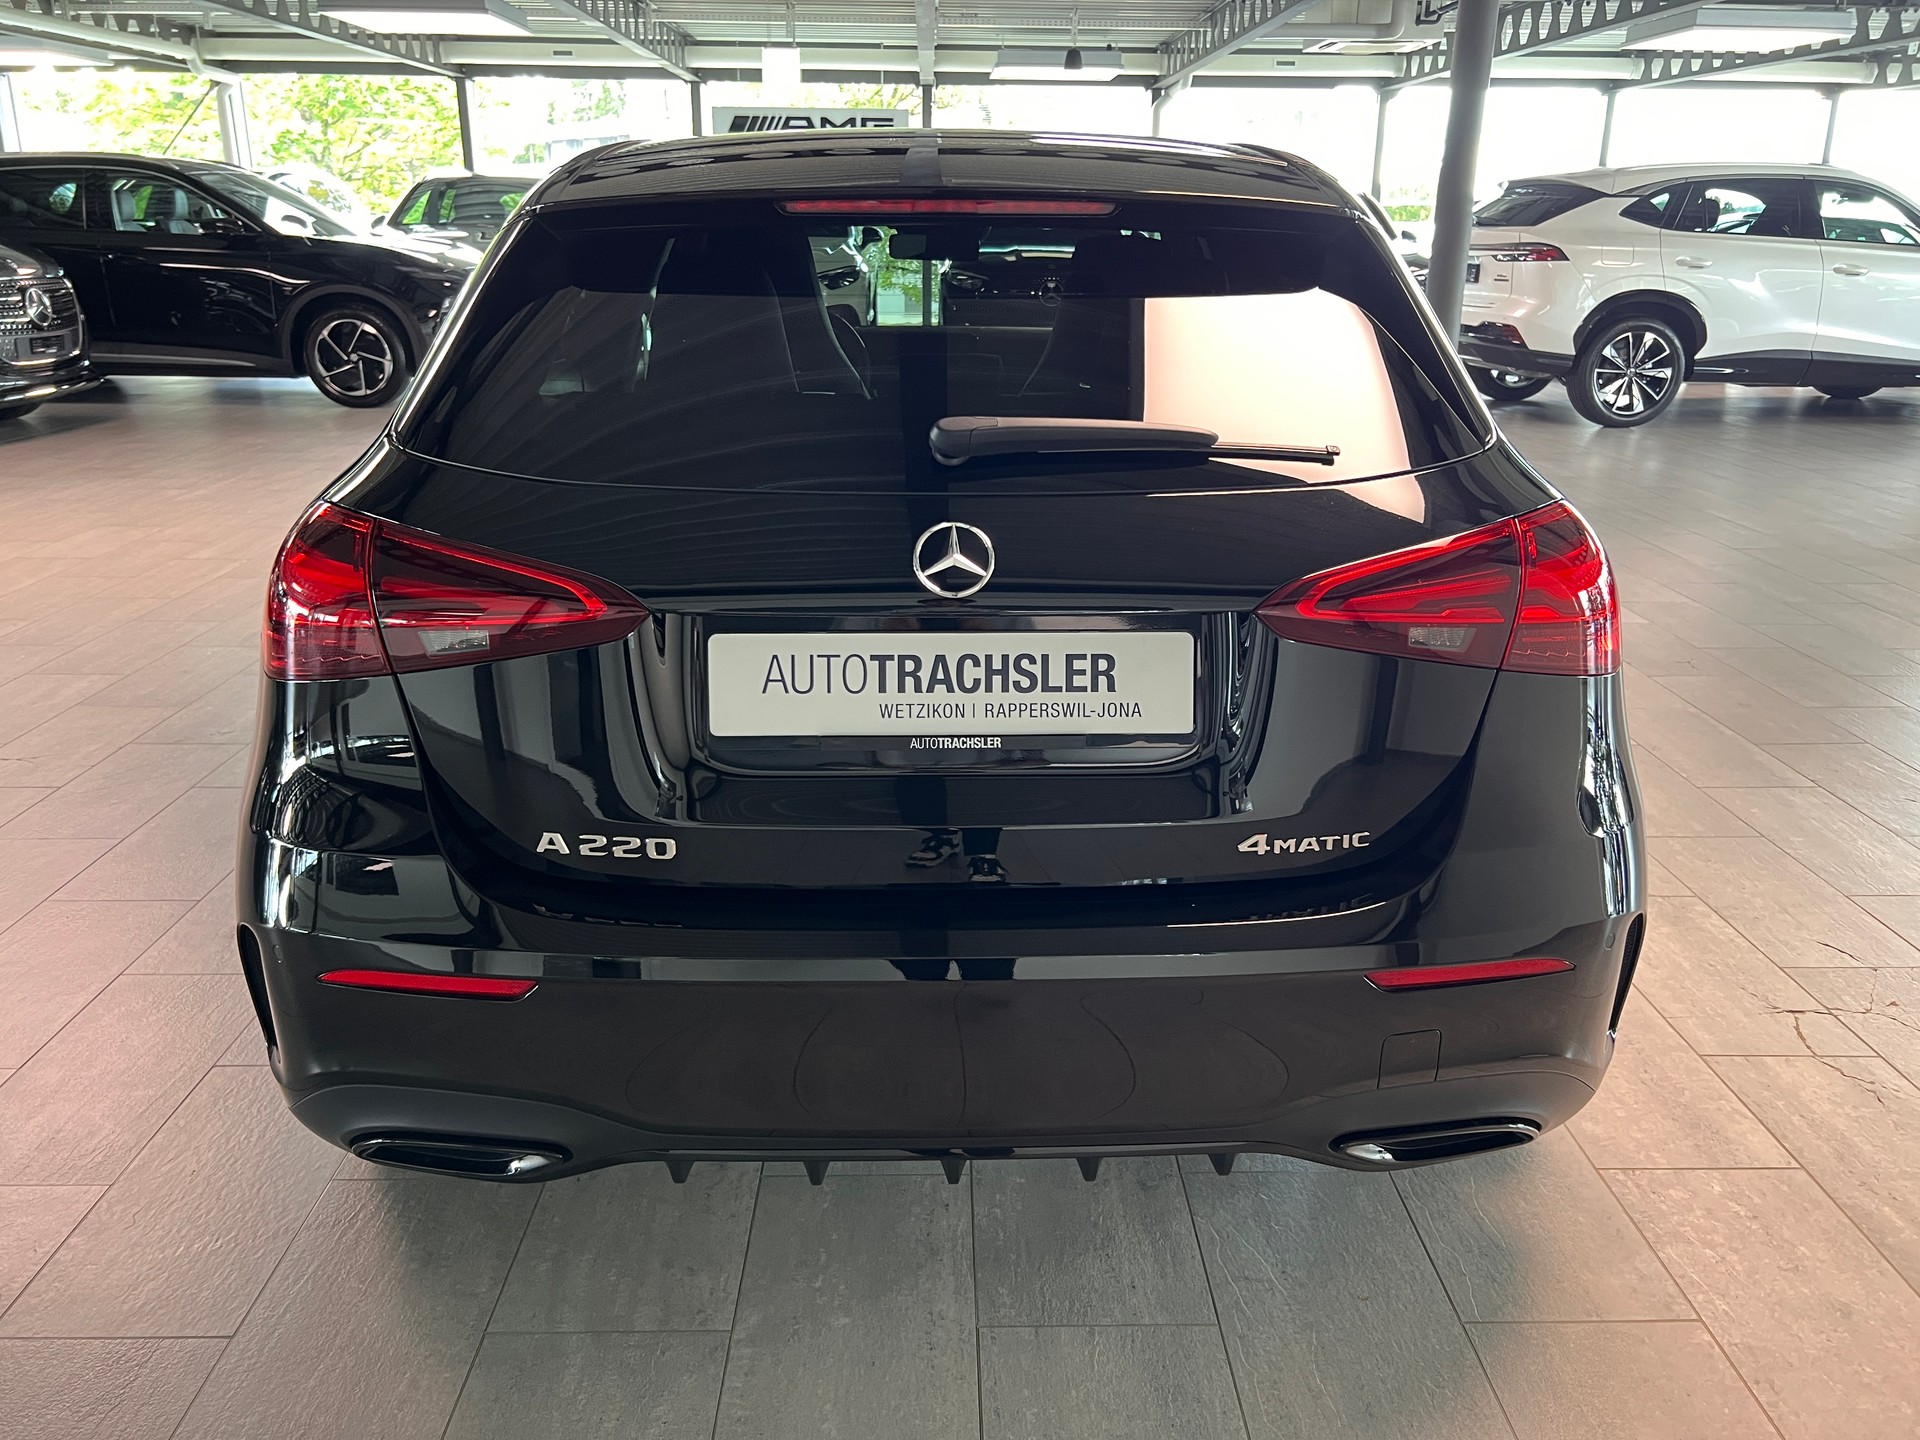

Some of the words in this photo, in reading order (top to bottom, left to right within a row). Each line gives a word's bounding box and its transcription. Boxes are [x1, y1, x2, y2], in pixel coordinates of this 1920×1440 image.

[781, 116, 894, 129] AMG
[762, 653, 1117, 694] AUTOTRACHSLER
[879, 703, 966, 719] WETZIKON
[984, 702, 1142, 719] RAPPERSWIL-JONA
[910, 737, 1002, 749] AUTOTRACHSLER
[536, 832, 570, 854] A
[578, 834, 677, 860] 220
[1237, 831, 1370, 855] 4MATIC
